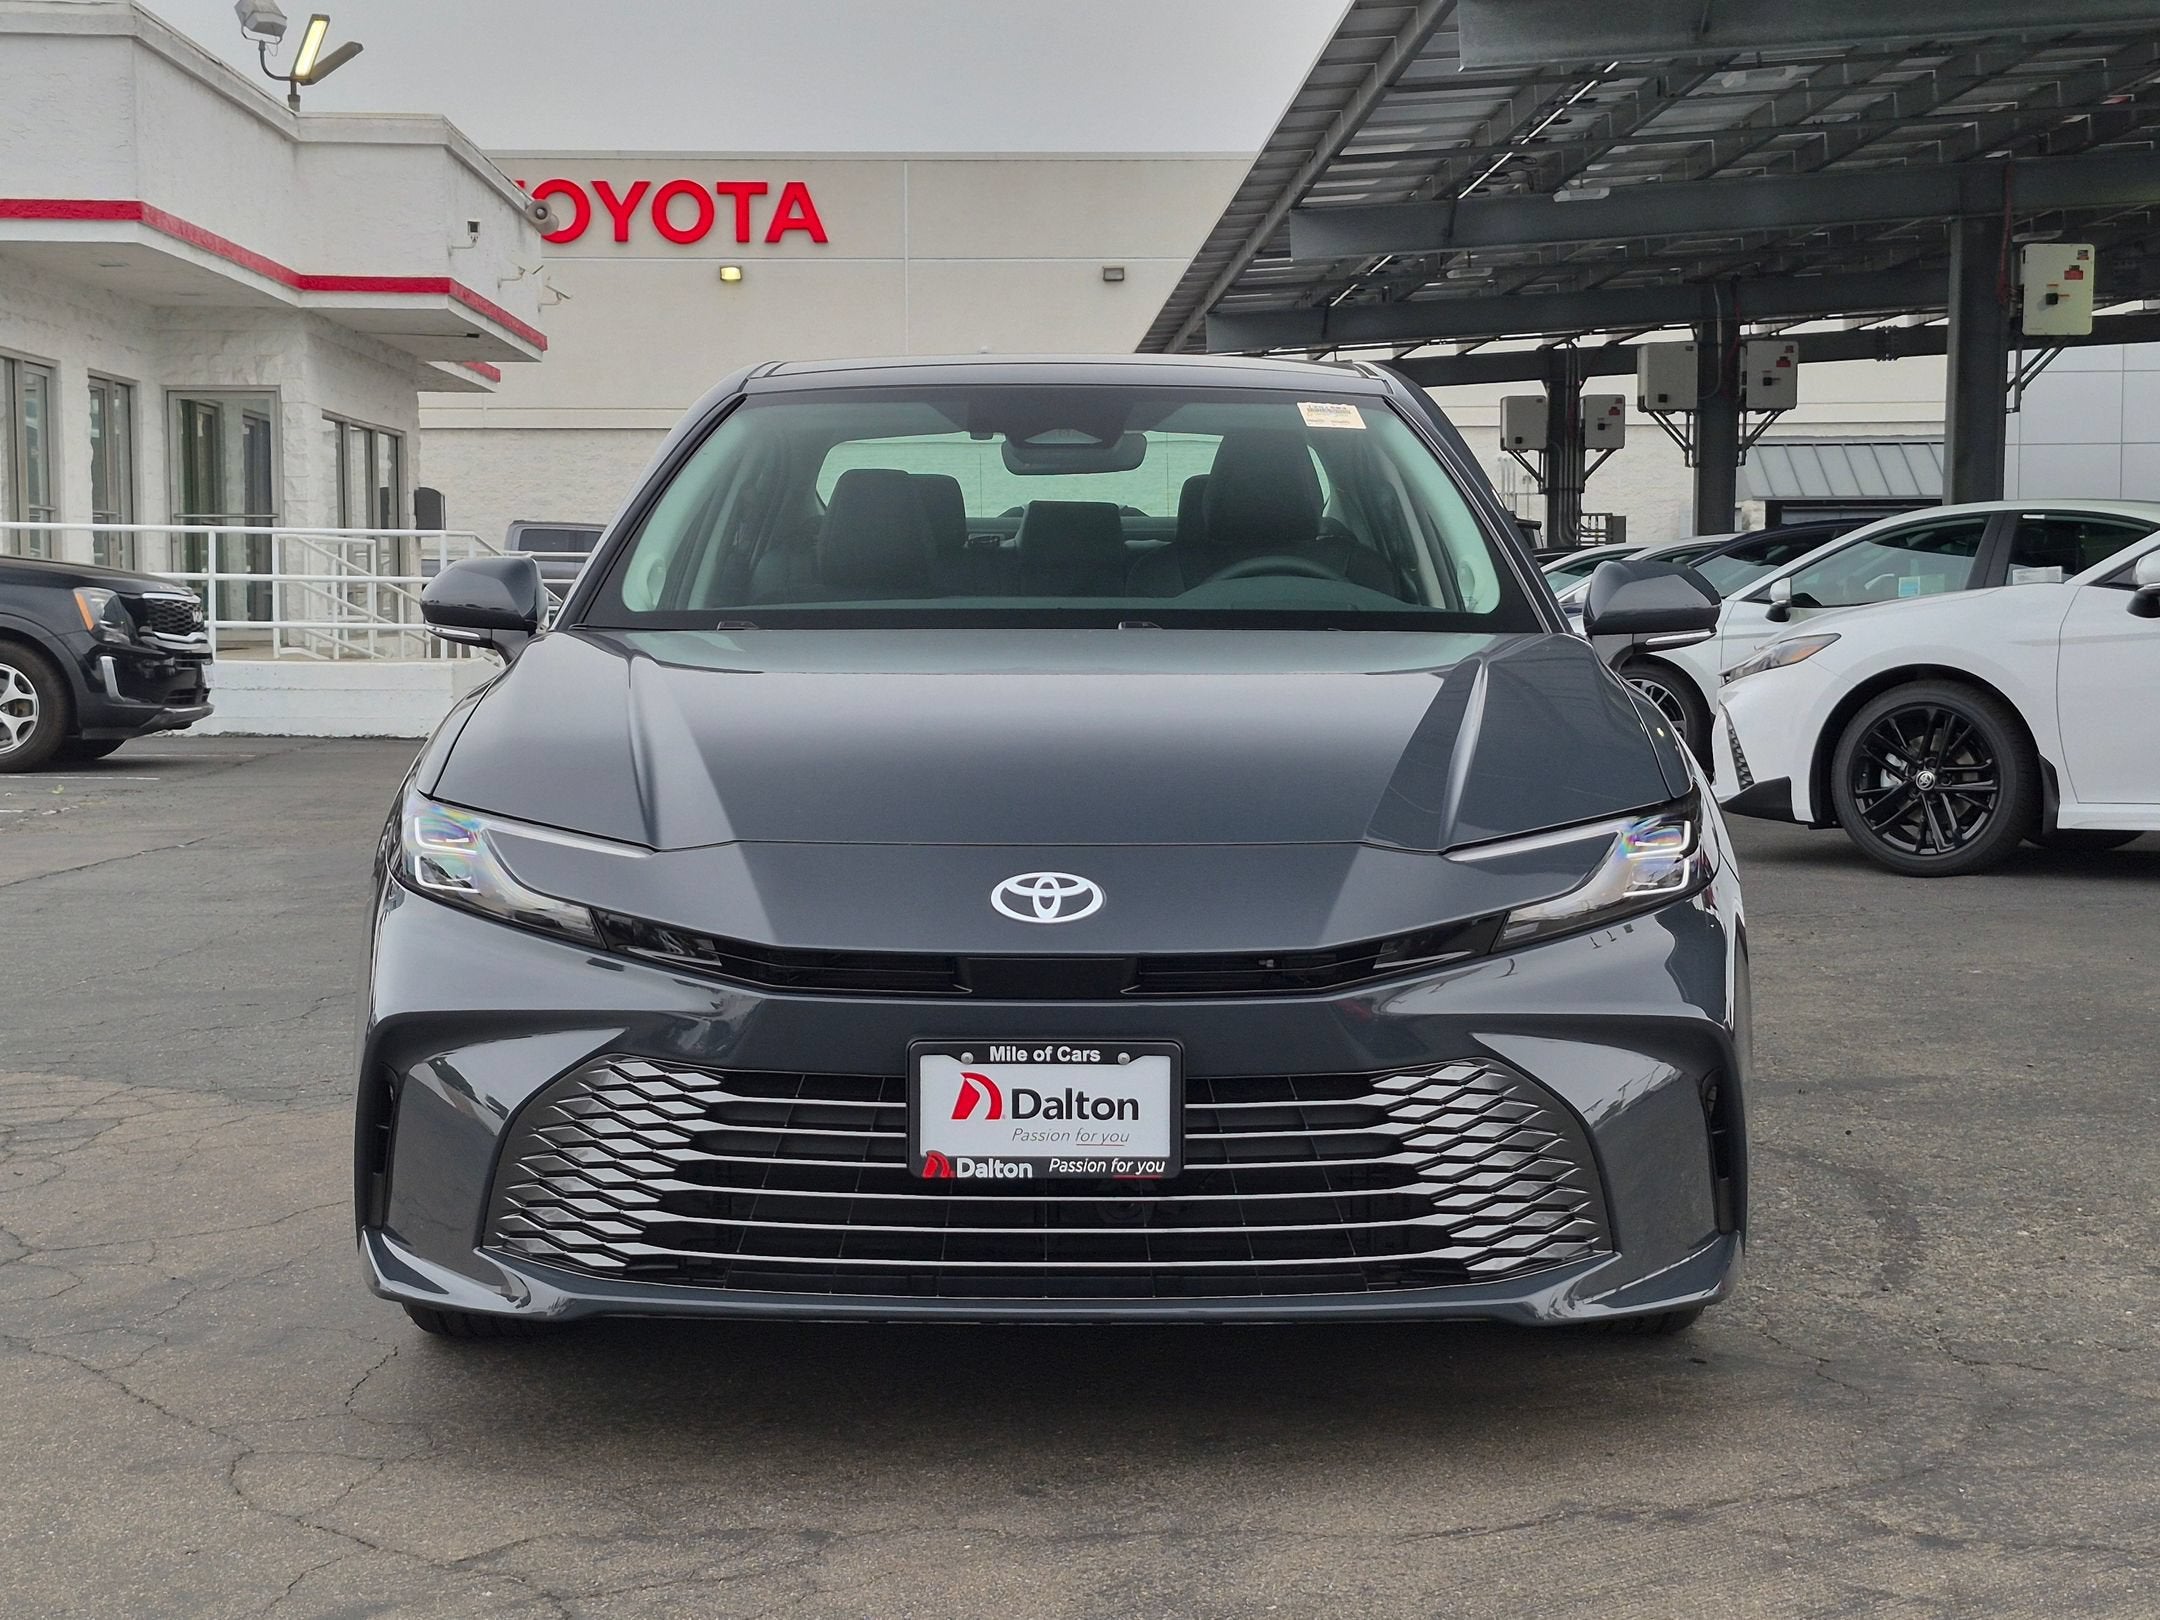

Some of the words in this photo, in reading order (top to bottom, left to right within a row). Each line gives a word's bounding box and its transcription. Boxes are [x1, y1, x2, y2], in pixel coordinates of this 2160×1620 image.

[514, 178, 829, 244] OYOTA
[990, 1046, 1027, 1062] Mile
[1033, 1046, 1053, 1062] of
[1057, 1046, 1101, 1062] Cars
[1011, 1087, 1139, 1120] Dalton
[1012, 1128, 1070, 1142] Passion
[1075, 1128, 1096, 1144] for
[1100, 1131, 1129, 1145] you
[956, 1158, 1033, 1179] Dalton
[1049, 1158, 1107, 1173] Passion
[1110, 1158, 1133, 1174] for
[1134, 1160, 1165, 1176] you
